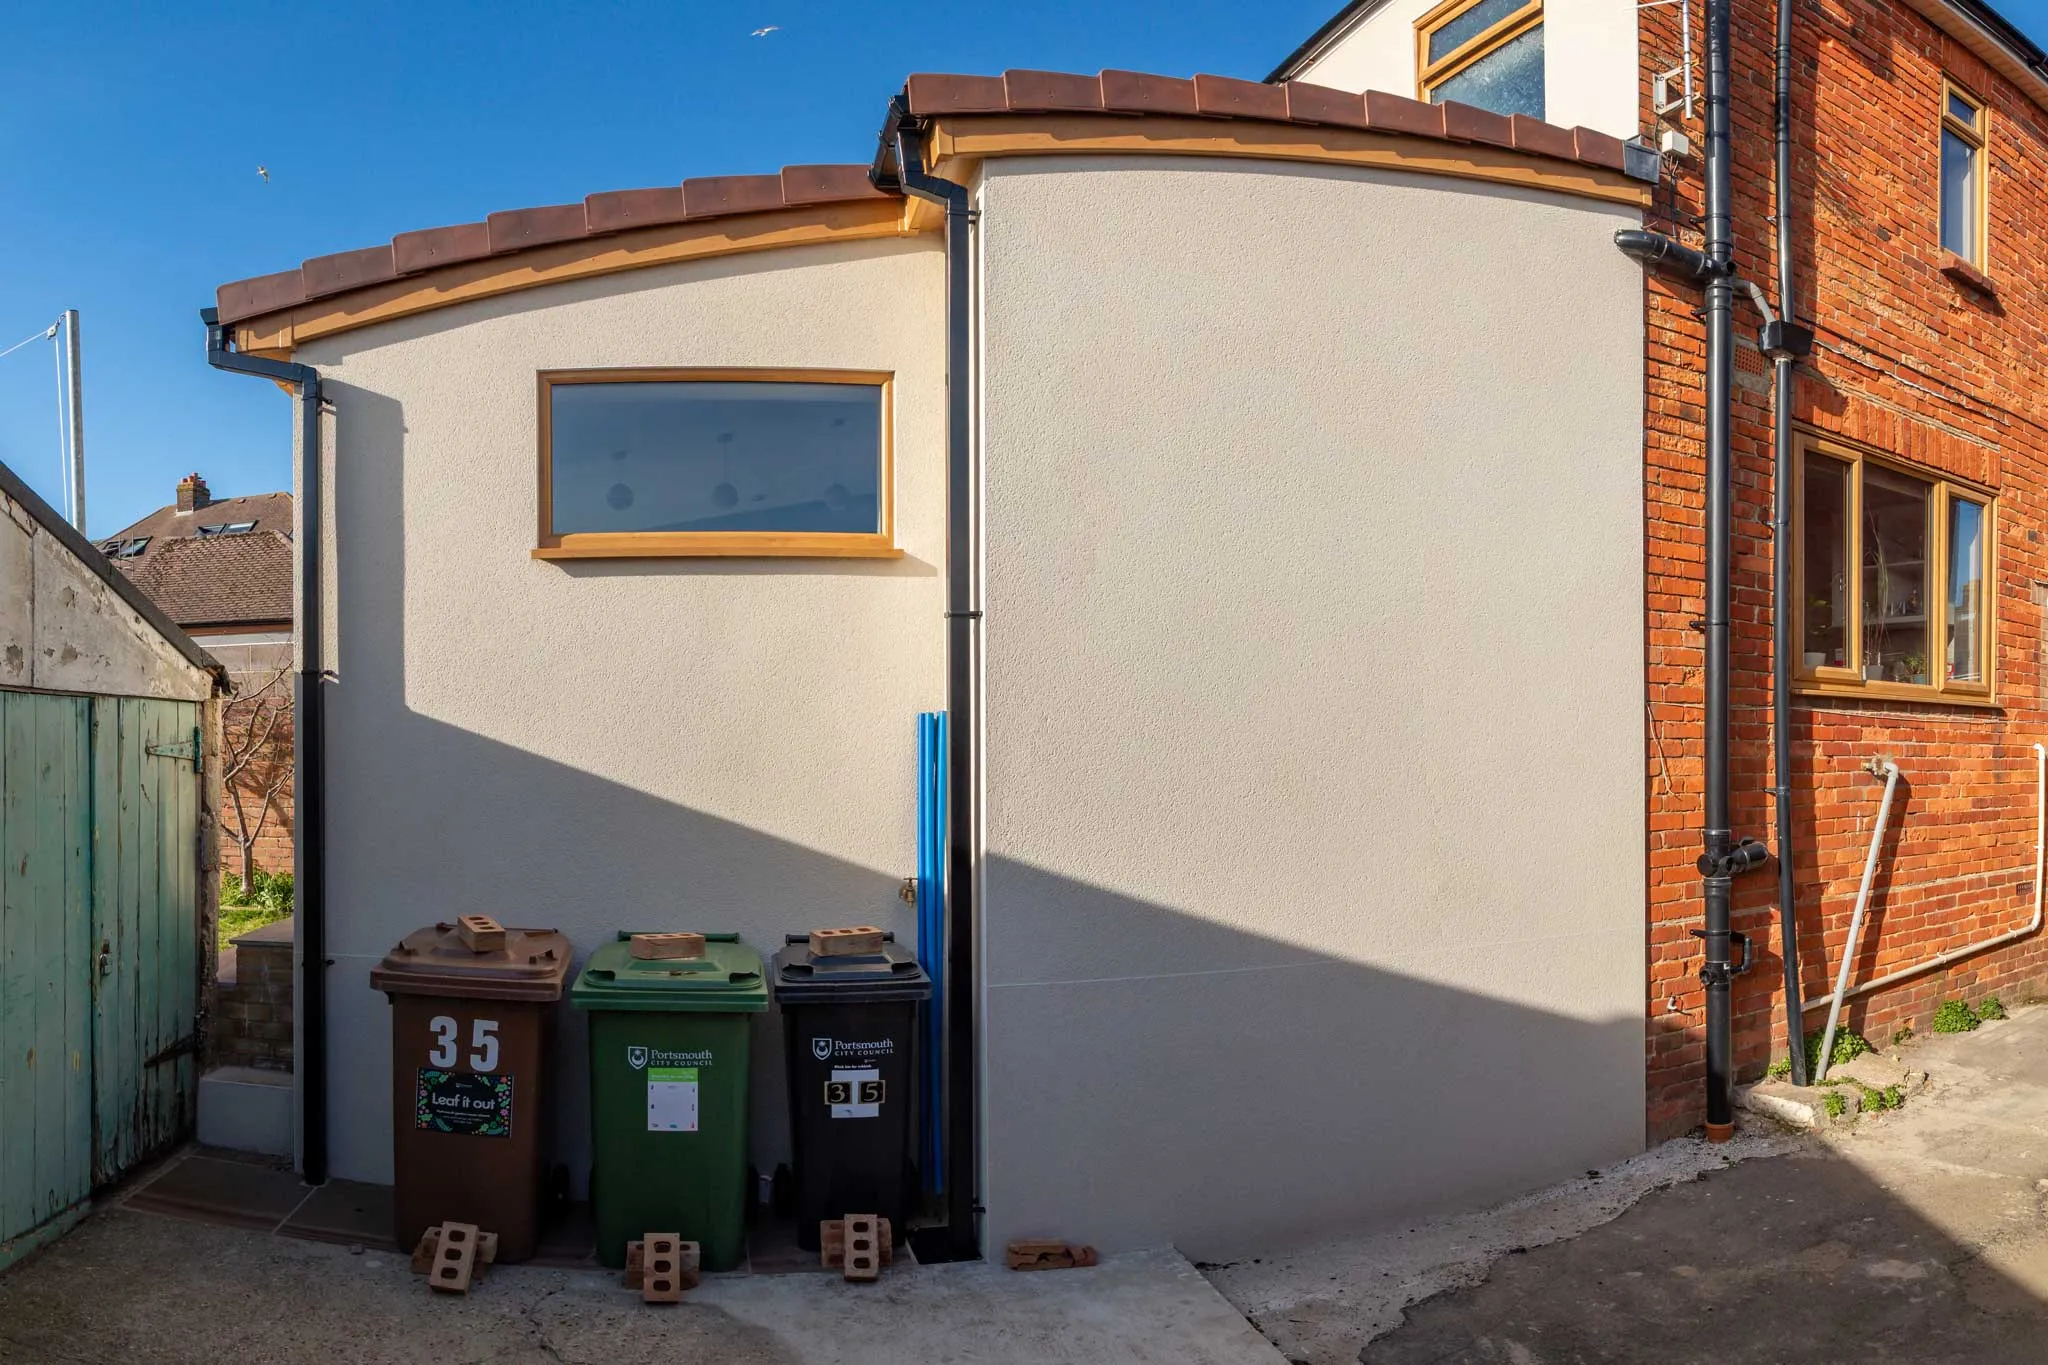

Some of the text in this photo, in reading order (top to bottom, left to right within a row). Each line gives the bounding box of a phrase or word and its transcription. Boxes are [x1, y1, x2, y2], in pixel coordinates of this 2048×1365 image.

[429, 1015, 499, 1072] 35
[834, 1037, 894, 1050] Portsmouth
[650, 1049, 713, 1060] Portsmouth
[857, 1048, 894, 1056] COUNCIL
[431, 1092, 496, 1110] Leaf it out
